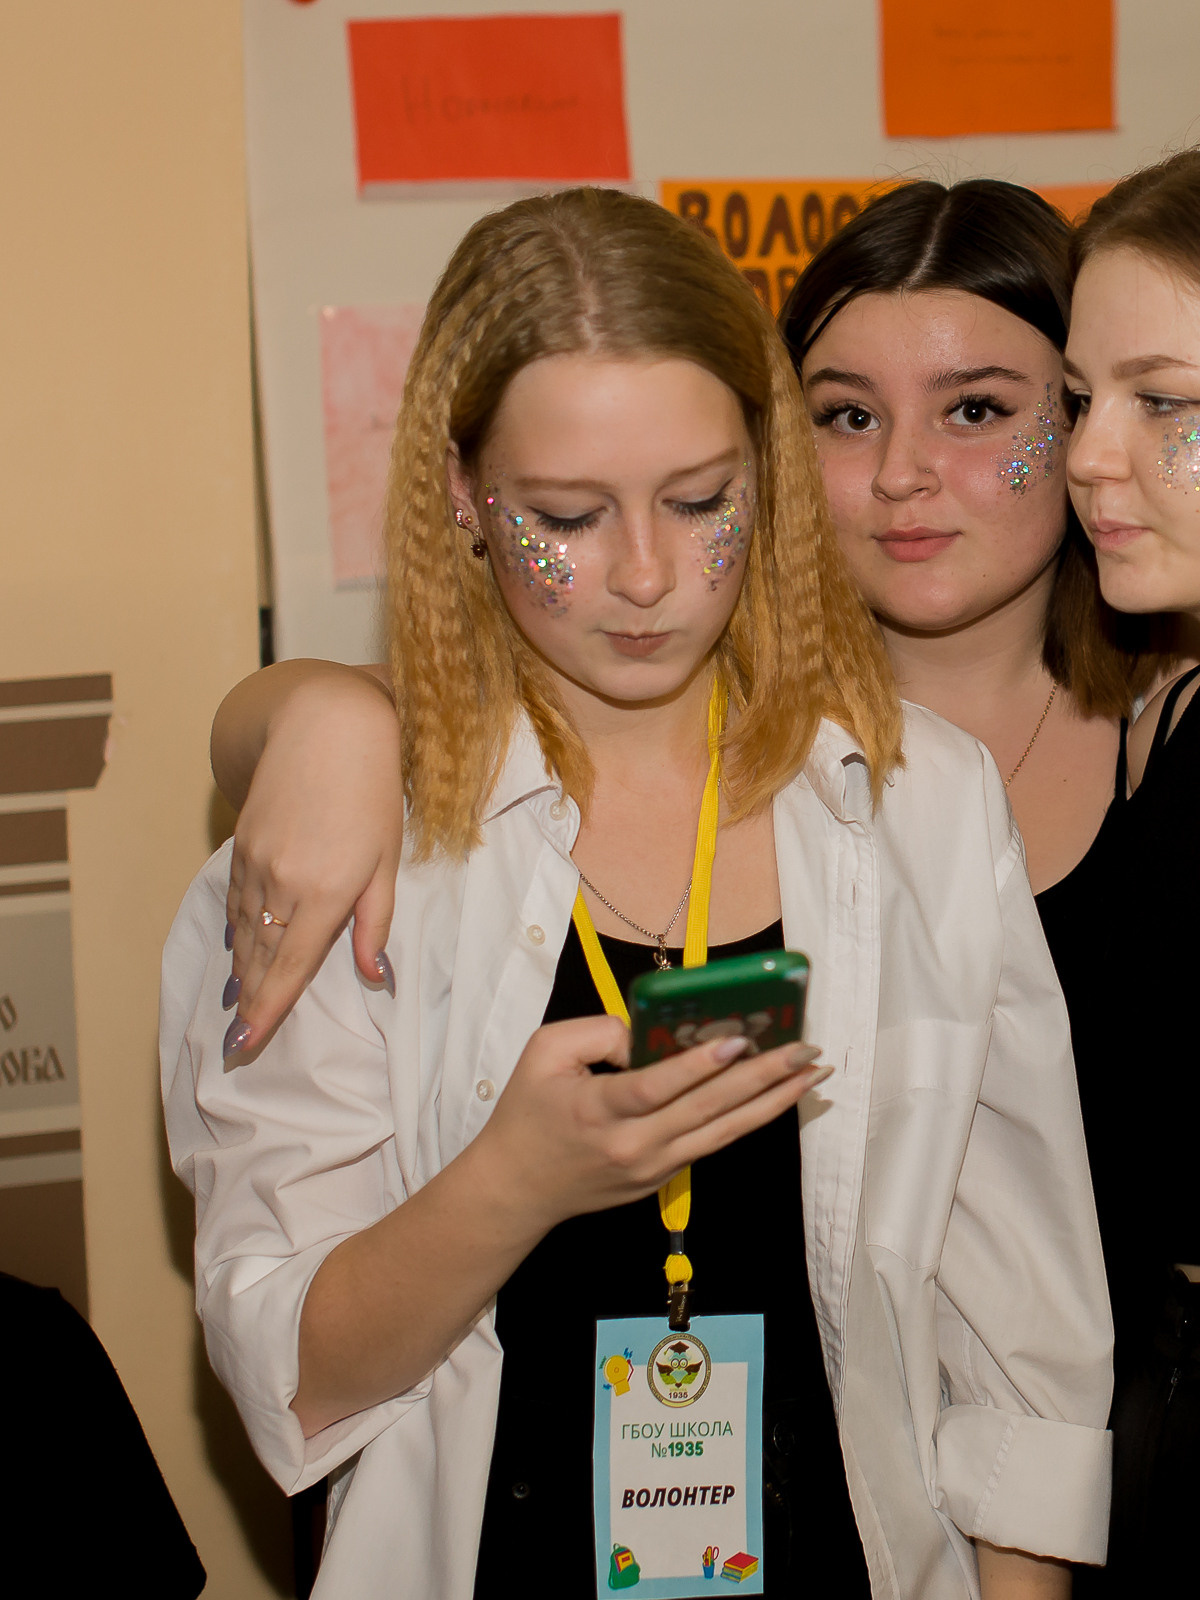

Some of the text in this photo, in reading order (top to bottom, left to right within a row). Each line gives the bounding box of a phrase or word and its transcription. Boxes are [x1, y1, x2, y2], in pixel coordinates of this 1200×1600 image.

[668, 1391, 688, 1399] 1935
[621, 1420, 734, 1440] ГБОУ ШКОЛА
[651, 1440, 704, 1458] №1935
[621, 1485, 736, 1509] ВОЛОНТЕР
